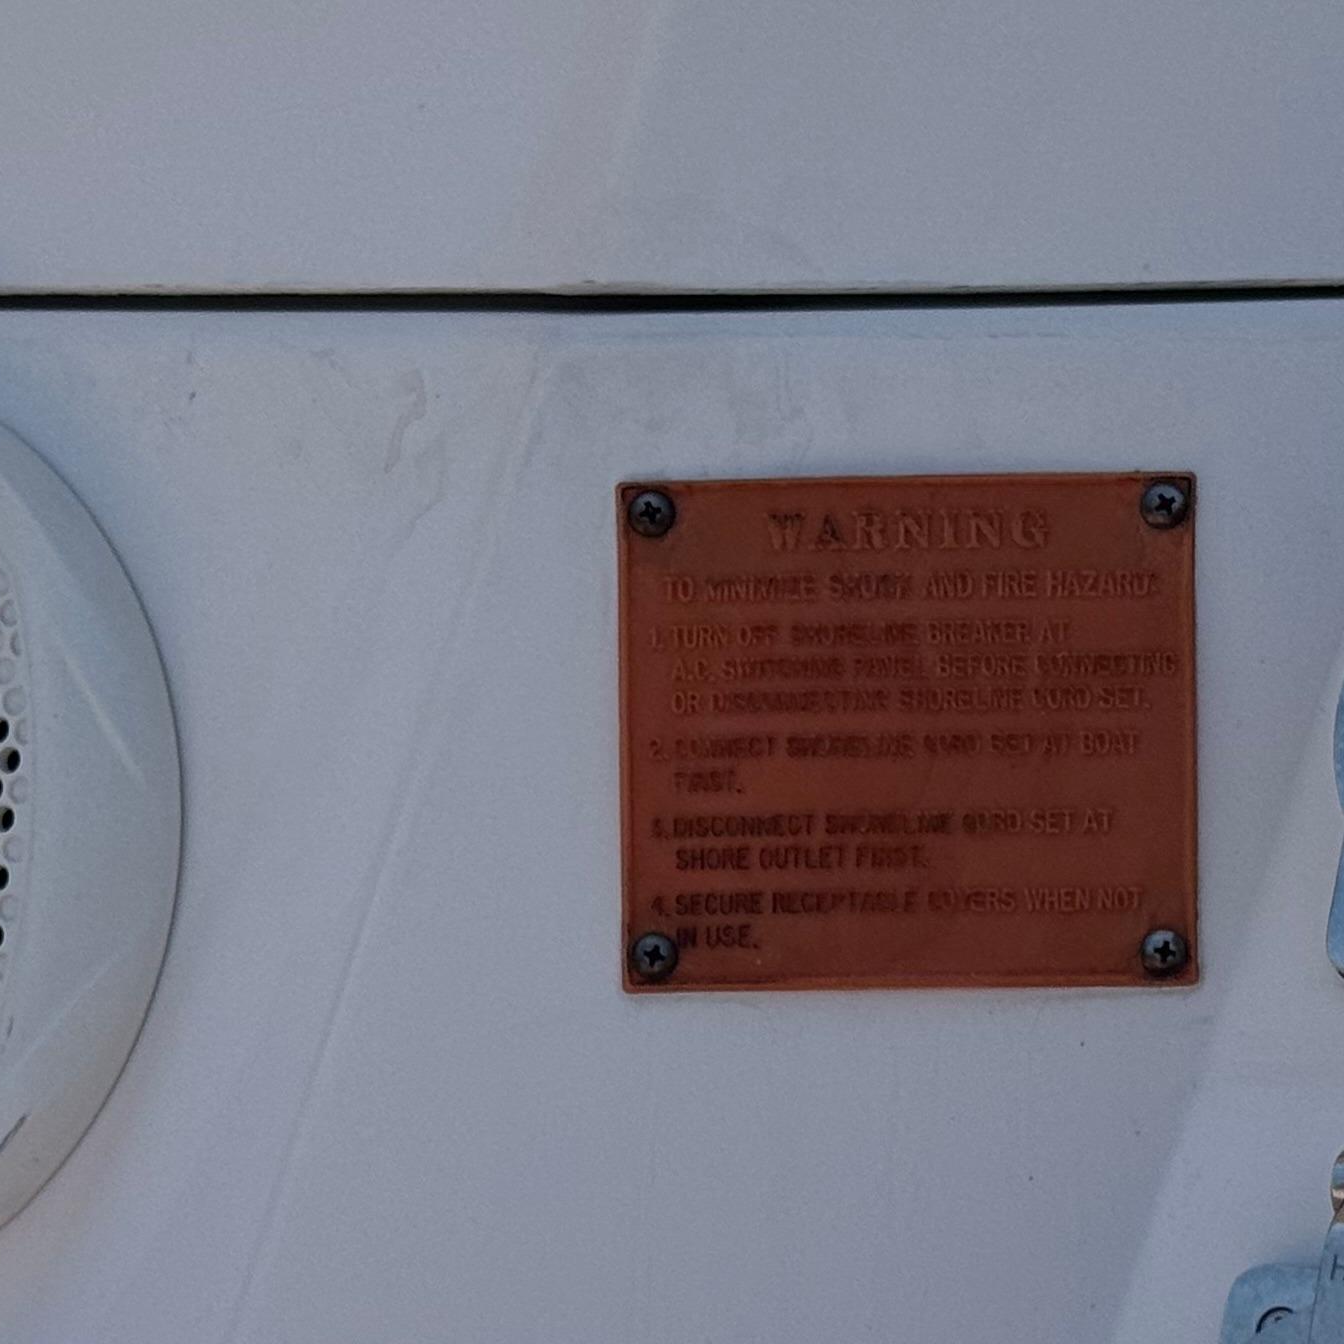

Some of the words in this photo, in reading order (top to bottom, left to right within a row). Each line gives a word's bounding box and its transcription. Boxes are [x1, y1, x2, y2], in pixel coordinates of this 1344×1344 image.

[763, 507, 1051, 550] WARNING
[662, 575, 695, 602] TO
[922, 570, 974, 599] AND
[981, 569, 1037, 597] FIRE
[670, 623, 729, 649] TURN
[736, 622, 779, 647] OFF
[1038, 618, 1071, 644] AT
[935, 653, 1028, 678] BEFORE
[670, 690, 700, 714] OR
[898, 686, 1026, 712] SHORELINE
[1031, 685, 1091, 710] CORD
[674, 734, 778, 759] CONNECT
[989, 732, 1034, 755] SET
[1080, 730, 1143, 755] BOAT
[672, 813, 815, 838] DISCONNECT
[1028, 809, 1074, 834] SET
[1082, 807, 1114, 833] AT
[675, 846, 751, 871] SHORE
[759, 845, 845, 870] OUTLET
[674, 891, 765, 916] SECURE
[1023, 886, 1091, 912] WHEN
[1096, 886, 1143, 911] NOT
[675, 924, 698, 949] IN
[706, 923, 762, 949] USE.
